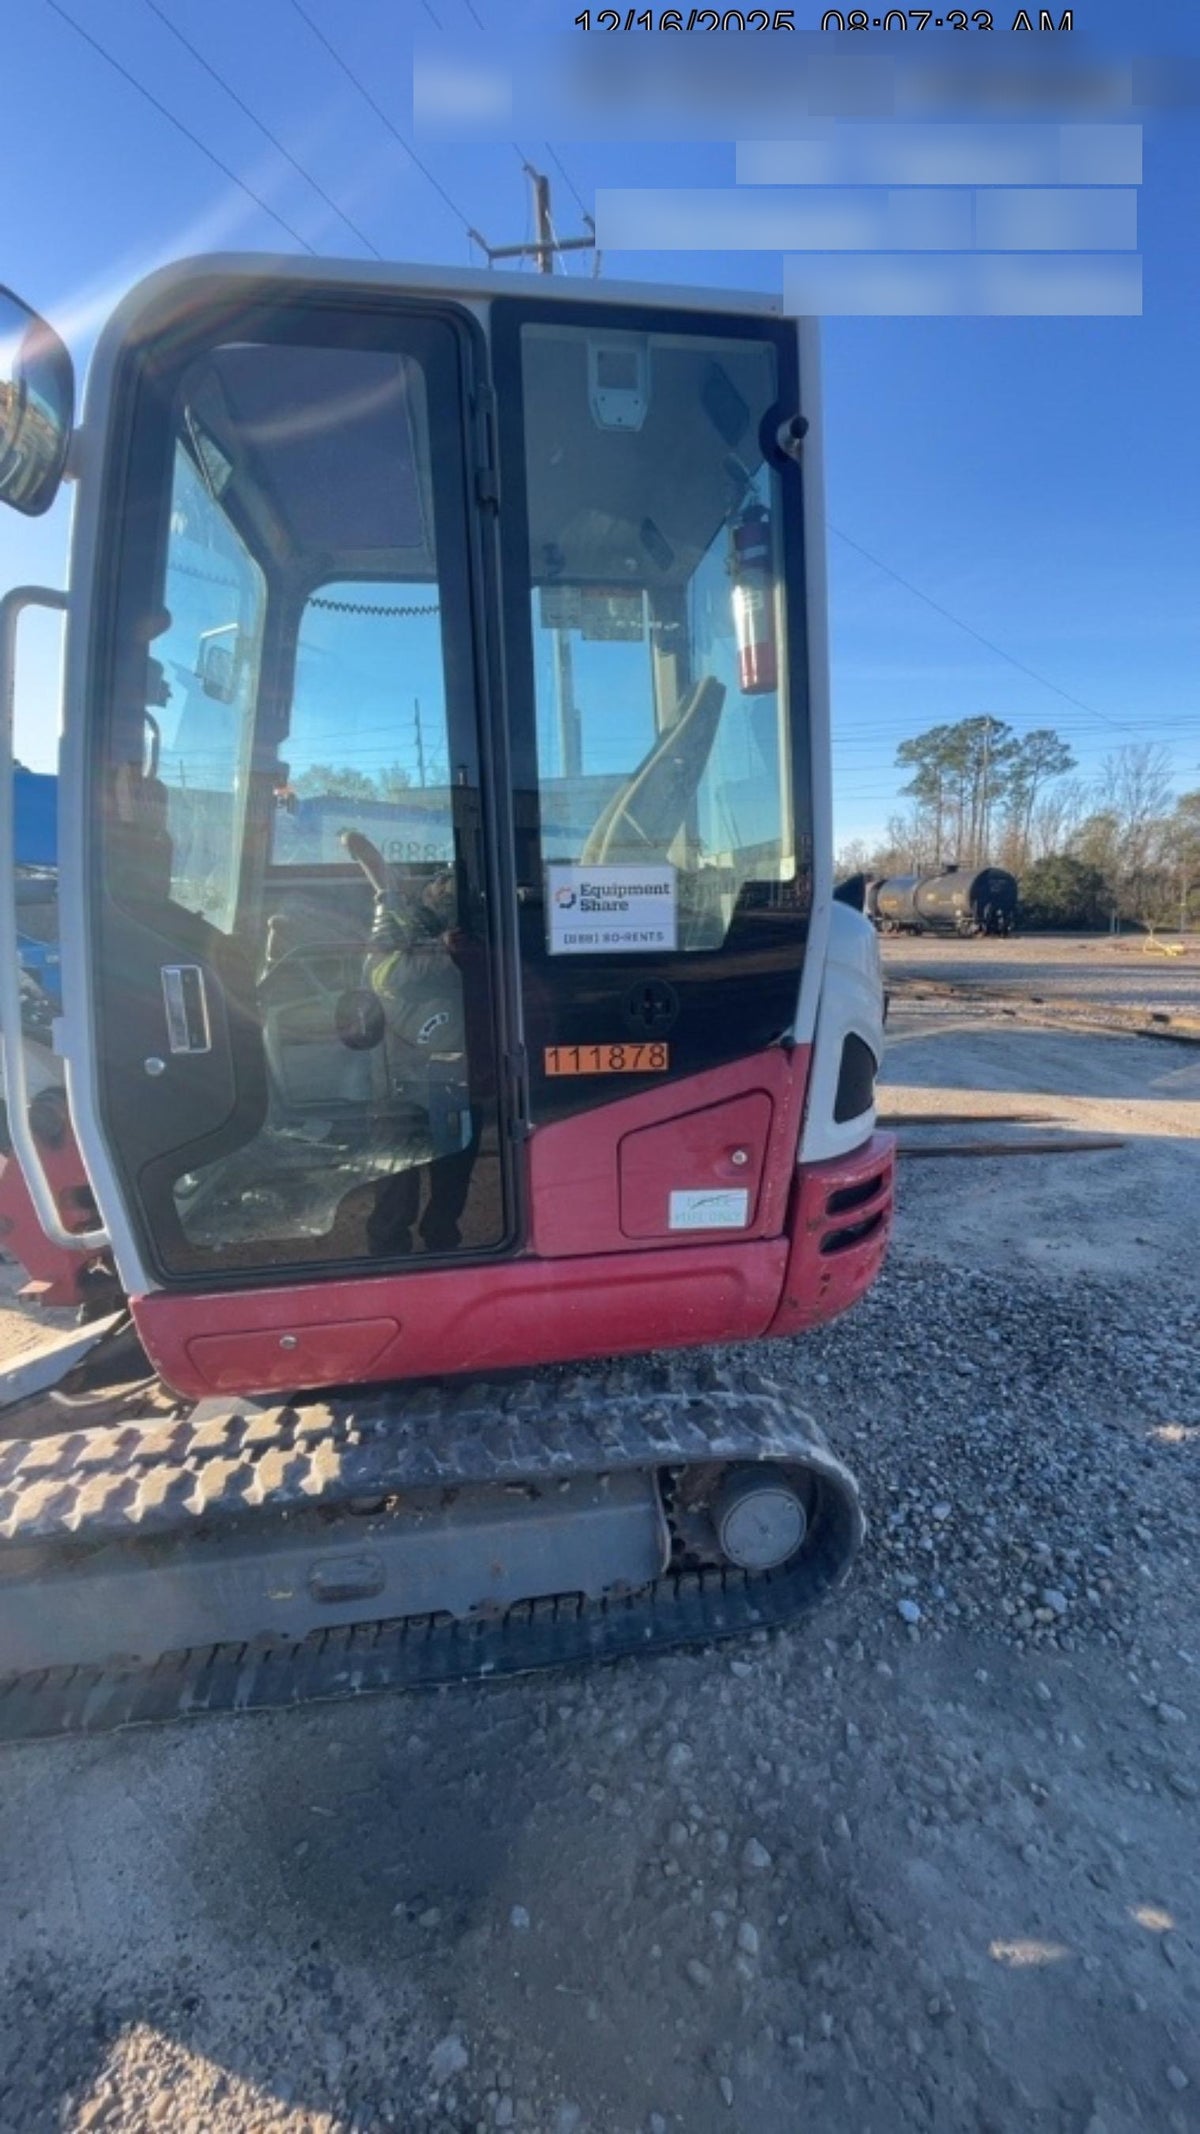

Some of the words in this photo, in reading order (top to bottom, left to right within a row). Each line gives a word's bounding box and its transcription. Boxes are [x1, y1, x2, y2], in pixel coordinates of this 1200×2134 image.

[581, 882, 670, 898] Equipment
[581, 899, 629, 912] Share
[547, 1043, 666, 1073] 111878
